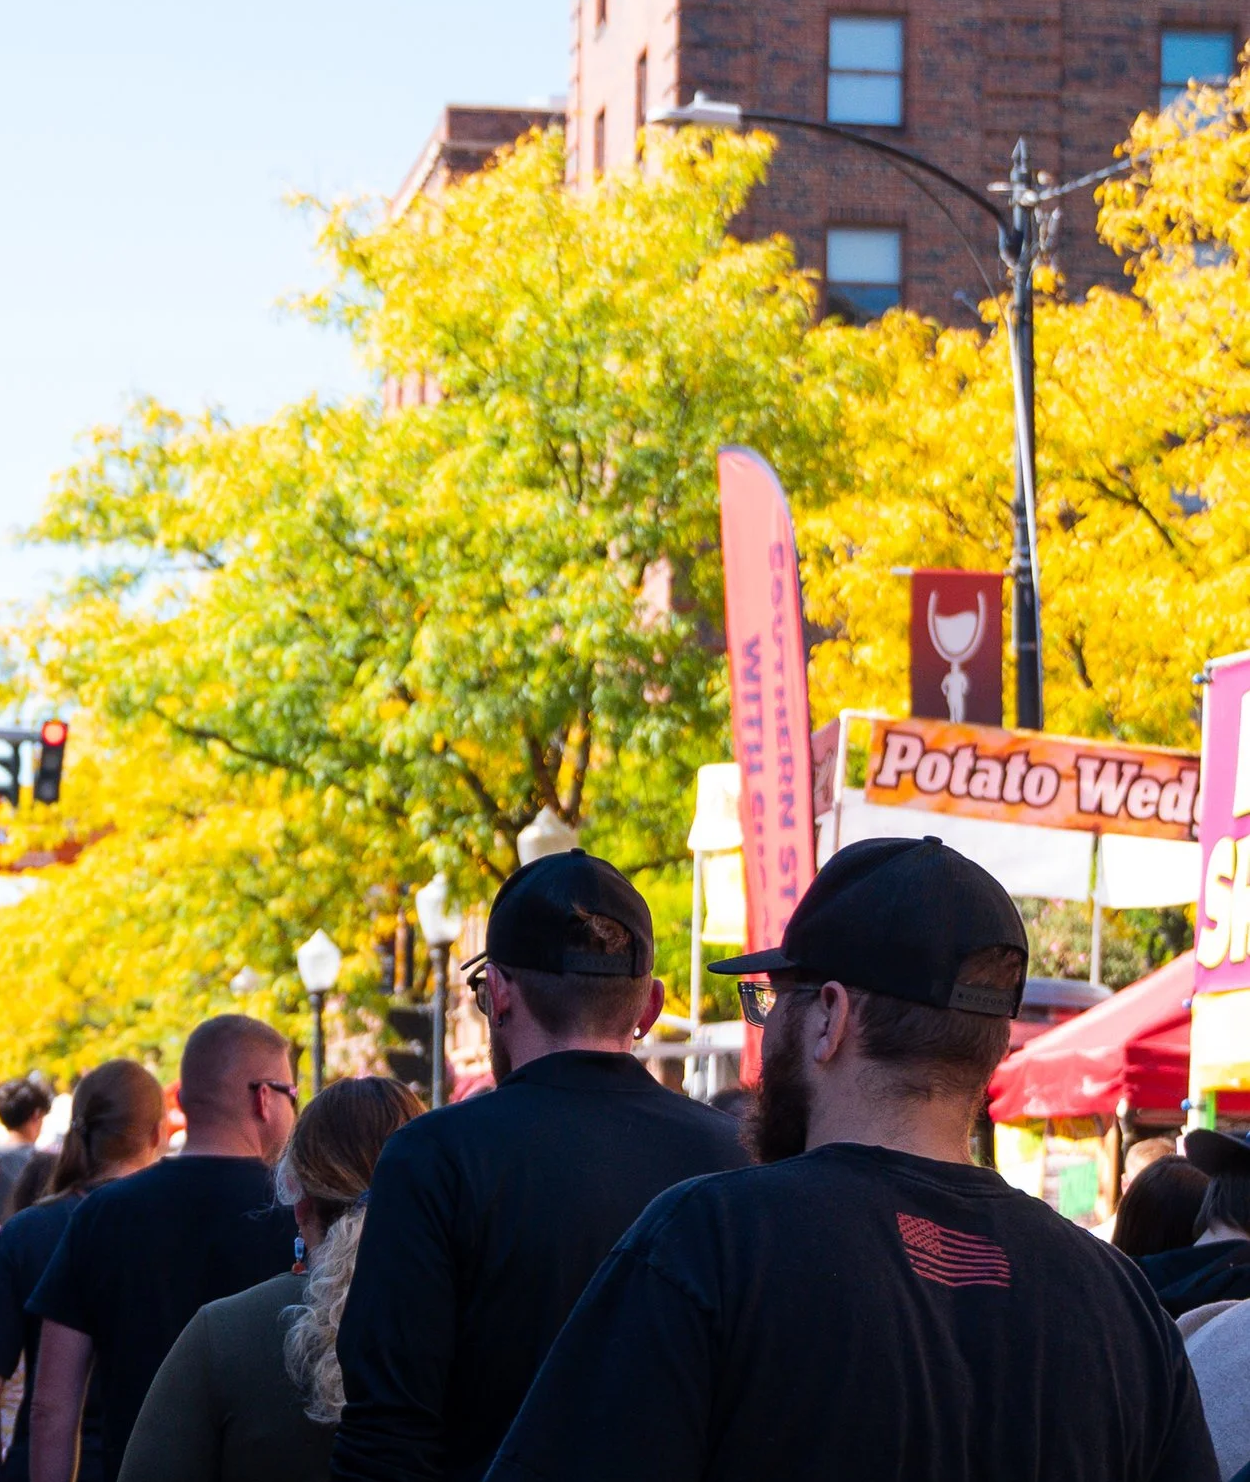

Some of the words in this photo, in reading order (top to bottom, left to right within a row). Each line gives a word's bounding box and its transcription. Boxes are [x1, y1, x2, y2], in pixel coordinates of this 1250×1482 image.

[874, 731, 1060, 808] Potato
[1076, 756, 1200, 840] Wed
[779, 844, 798, 931] ST
